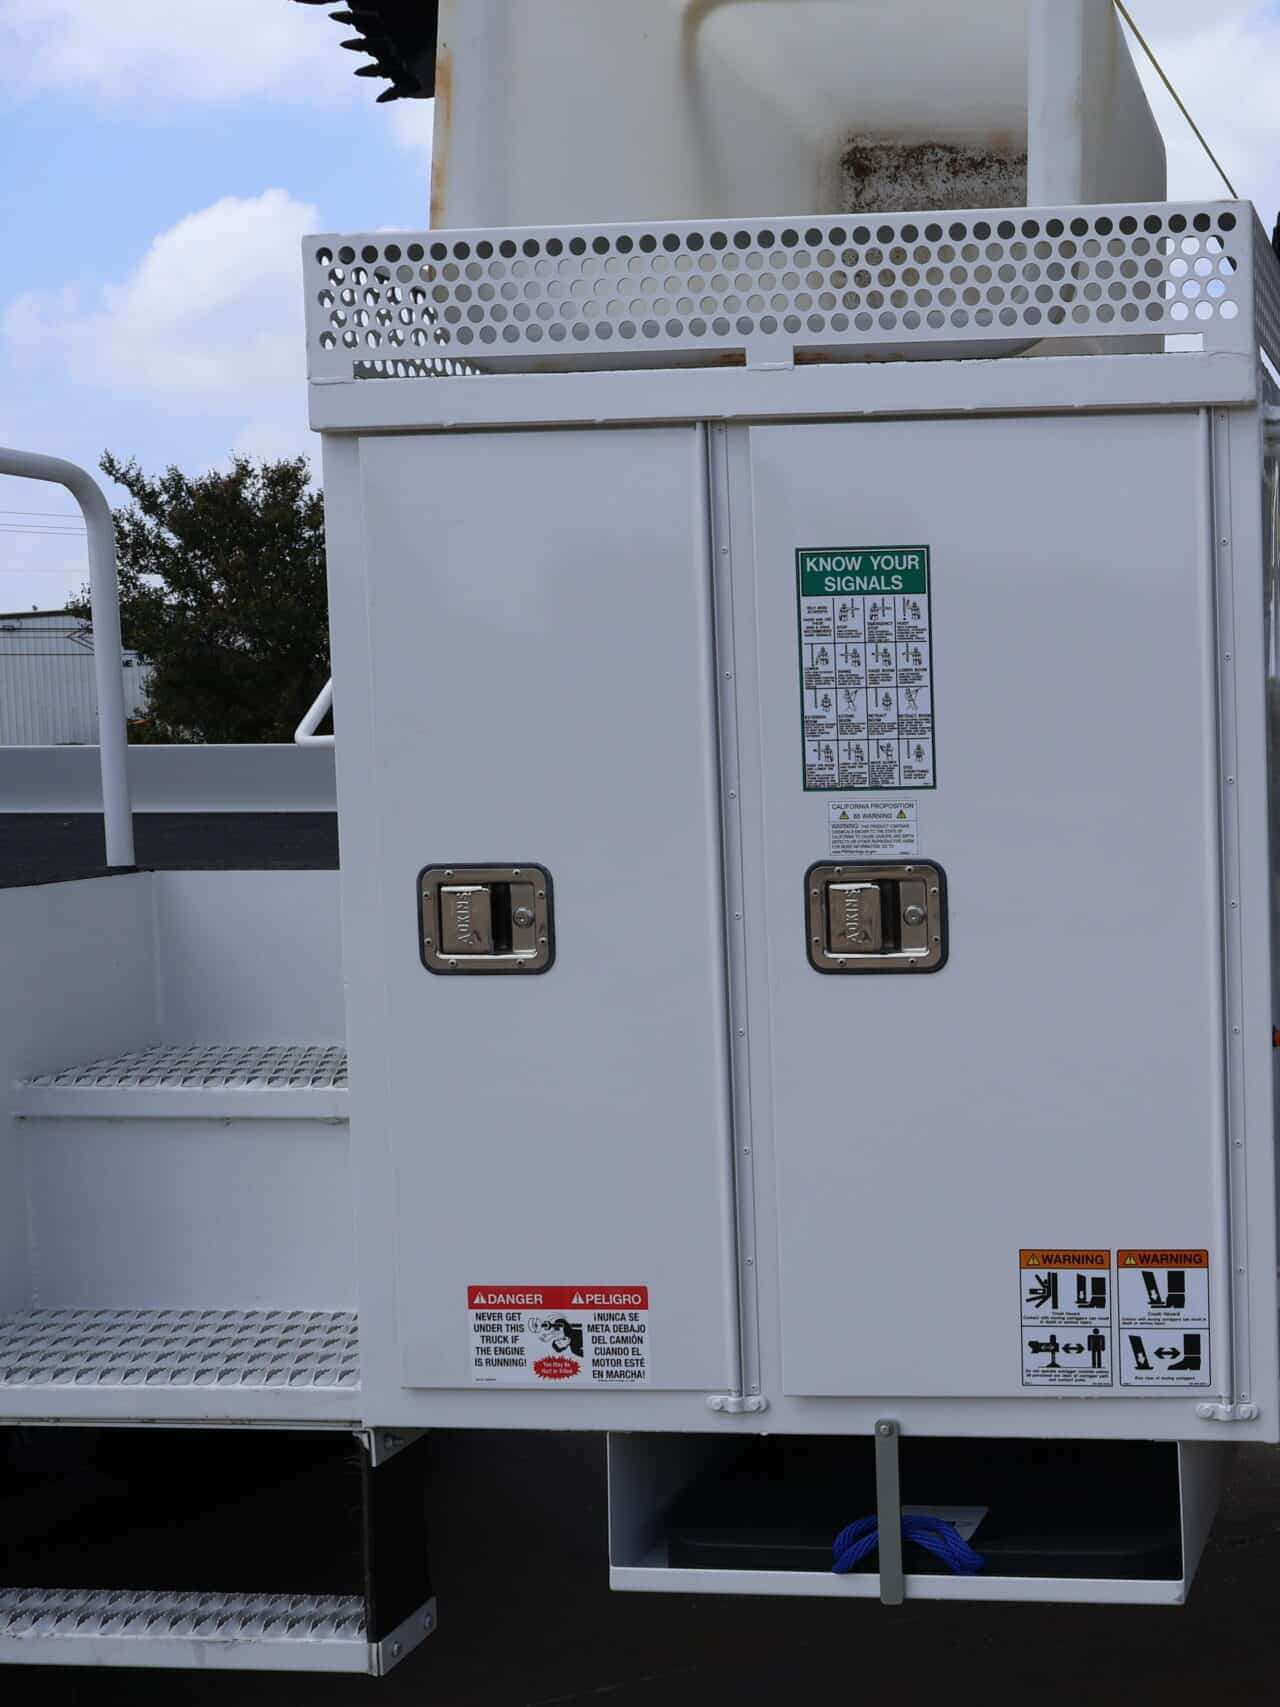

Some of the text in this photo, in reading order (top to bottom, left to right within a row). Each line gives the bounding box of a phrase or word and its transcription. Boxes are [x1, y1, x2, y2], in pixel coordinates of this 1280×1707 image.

[806, 554, 920, 572] KNOW YOUR
[824, 575, 903, 591] SIGNALS
[1042, 1255, 1104, 1265] WARNING
[1139, 1253, 1202, 1264] WARNING
[488, 1293, 543, 1305] DANGER
[584, 1293, 642, 1305] PELIGRO
[475, 1312, 522, 1321] NEVER GET
[629, 1312, 640, 1321] SE
[474, 1324, 524, 1333] UNDER THIS
[587, 1324, 646, 1333] META DEBAJO
[480, 1335, 520, 1344] TRUCK IF
[591, 1334, 643, 1345] DEL CAMIÓN
[476, 1347, 525, 1356] THE ENGINE
[594, 1347, 642, 1356] CUANDO EL
[474, 1358, 527, 1367] IS RUNNING!
[592, 1358, 645, 1368] MOTOR ESTÉ
[592, 1370, 645, 1379] EN MARCHA!
